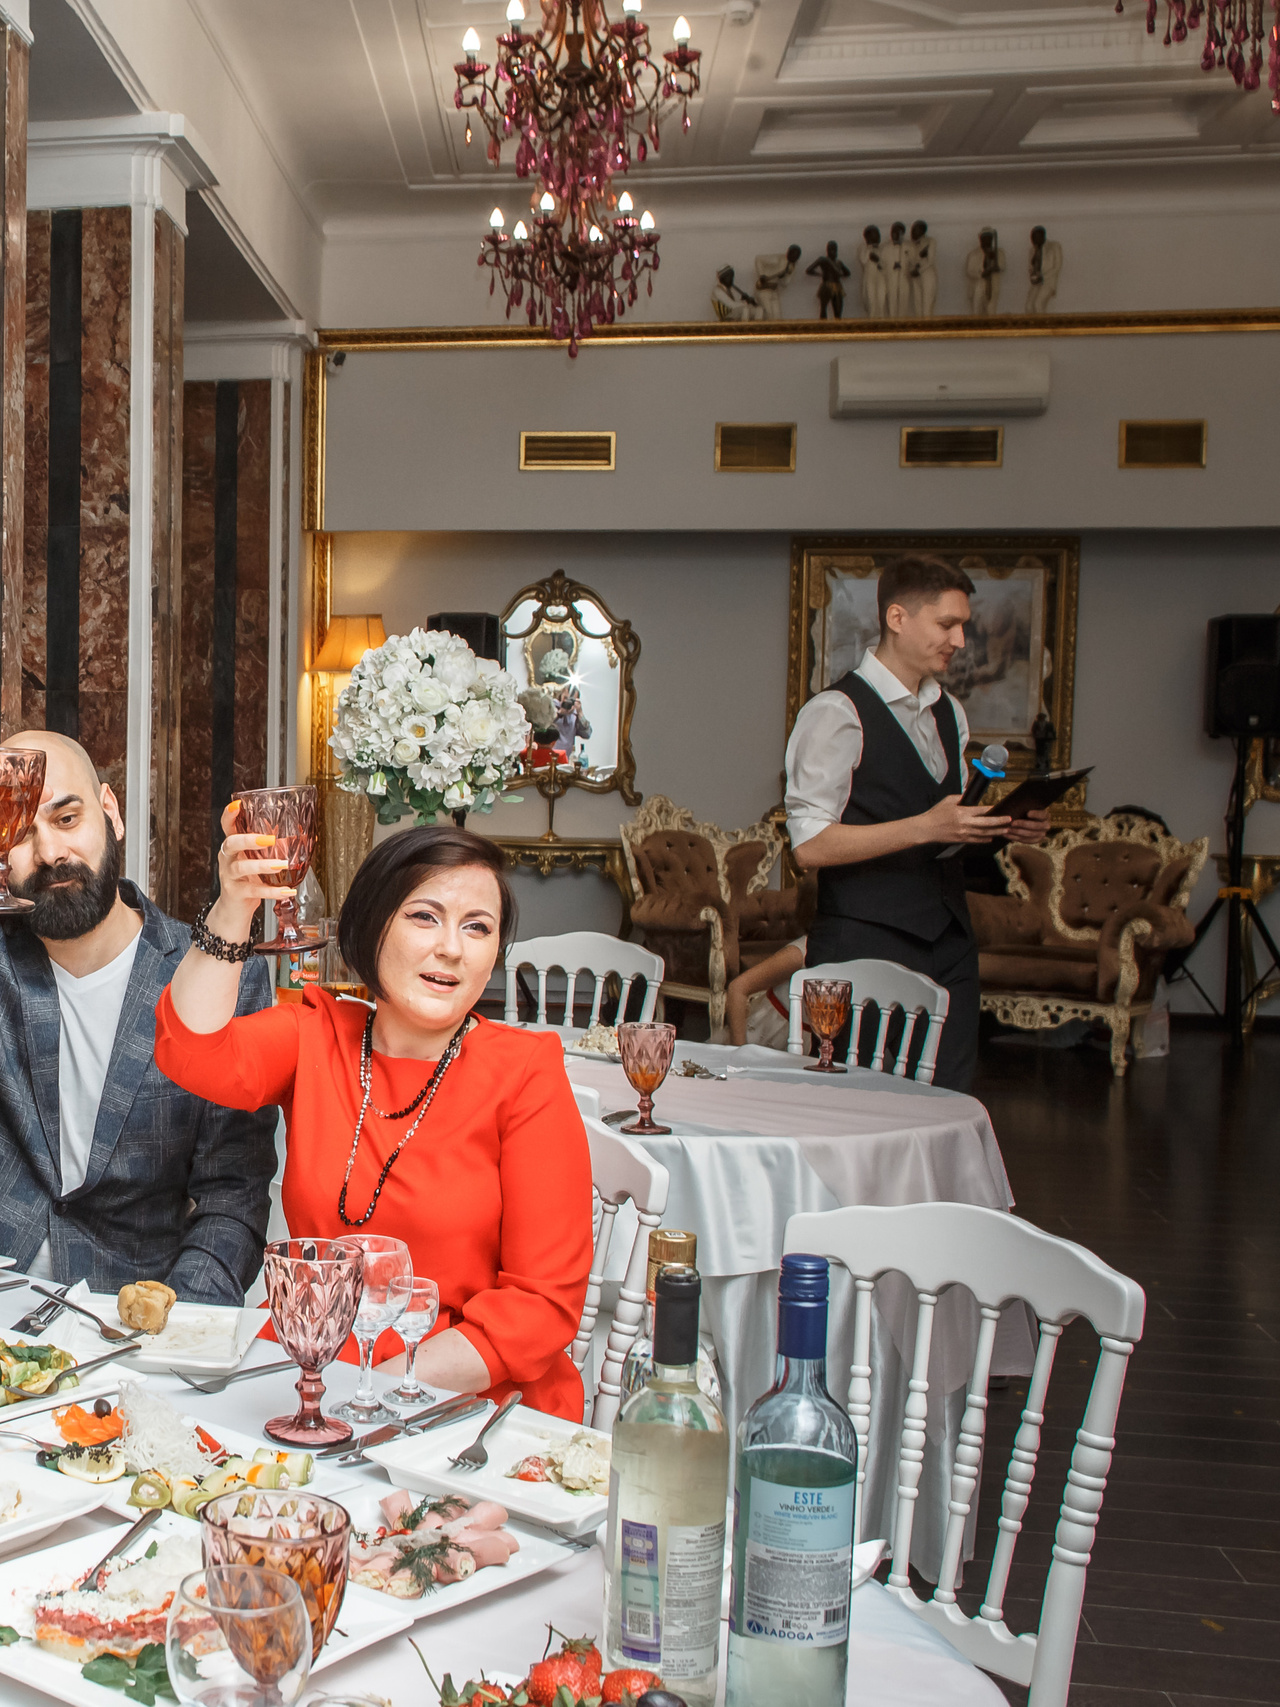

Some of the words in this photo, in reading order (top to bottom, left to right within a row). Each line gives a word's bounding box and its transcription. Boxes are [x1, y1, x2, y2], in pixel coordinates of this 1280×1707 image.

[794, 1491, 823, 1505] ESTE
[779, 1503, 805, 1513] VINHO
[807, 1505, 830, 1513] VERDE
[764, 1626, 814, 1641] LADOGA
